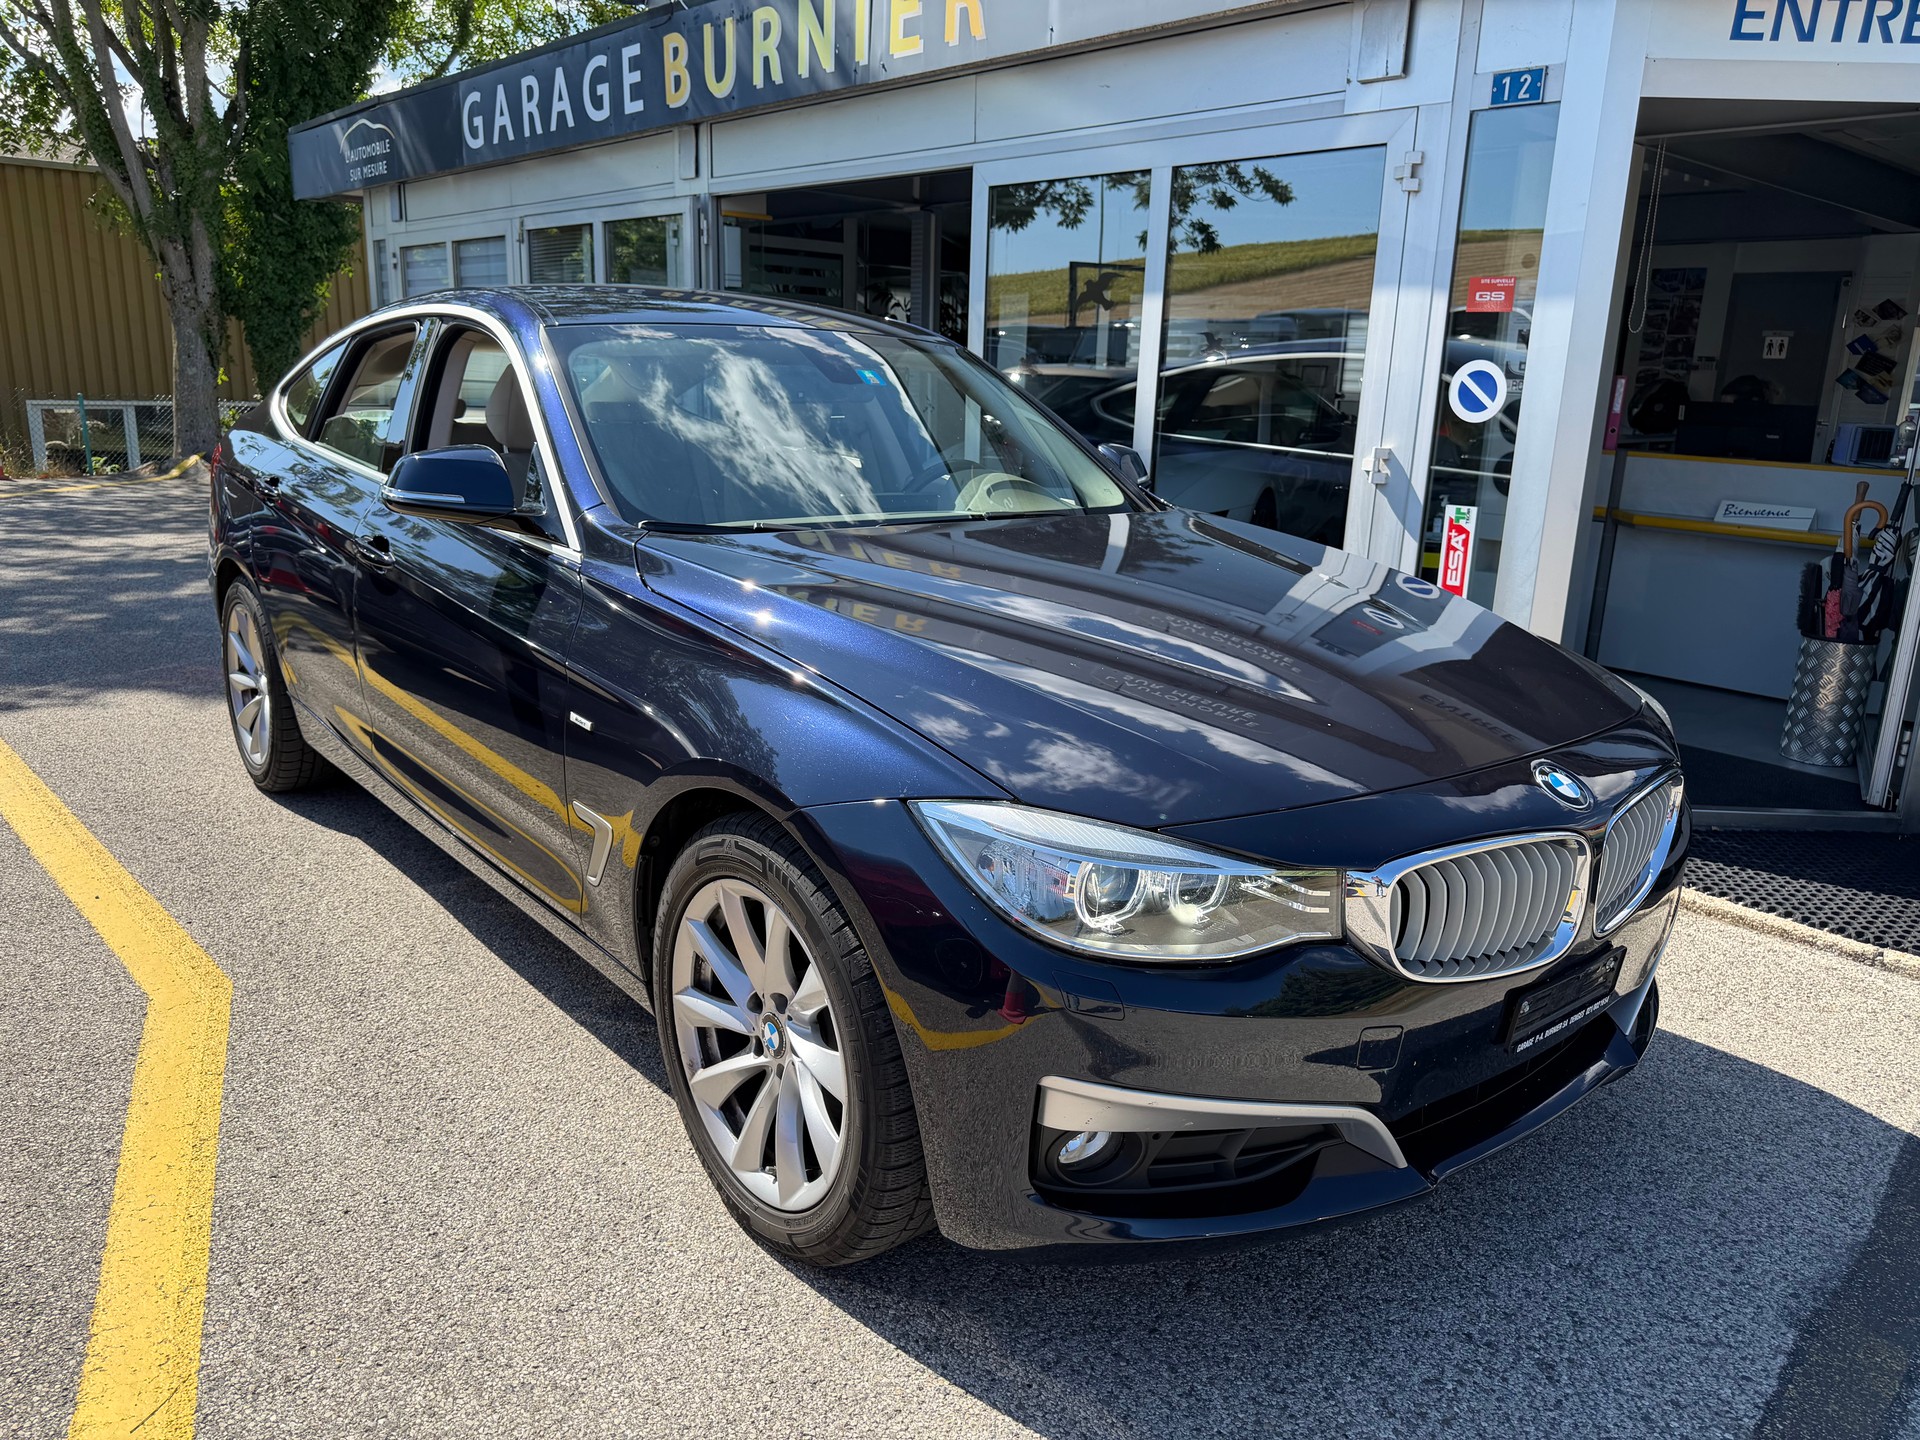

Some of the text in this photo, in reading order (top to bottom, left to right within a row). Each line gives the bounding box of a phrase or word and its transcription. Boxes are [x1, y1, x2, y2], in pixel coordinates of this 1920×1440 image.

[462, 43, 645, 150] GARAGE
[345, 139, 390, 163] L'AUTOMOBILE
[350, 160, 388, 181] SUR MESURE
[1475, 291, 1505, 301] GS
[1723, 503, 1791, 517] Bienvenue
